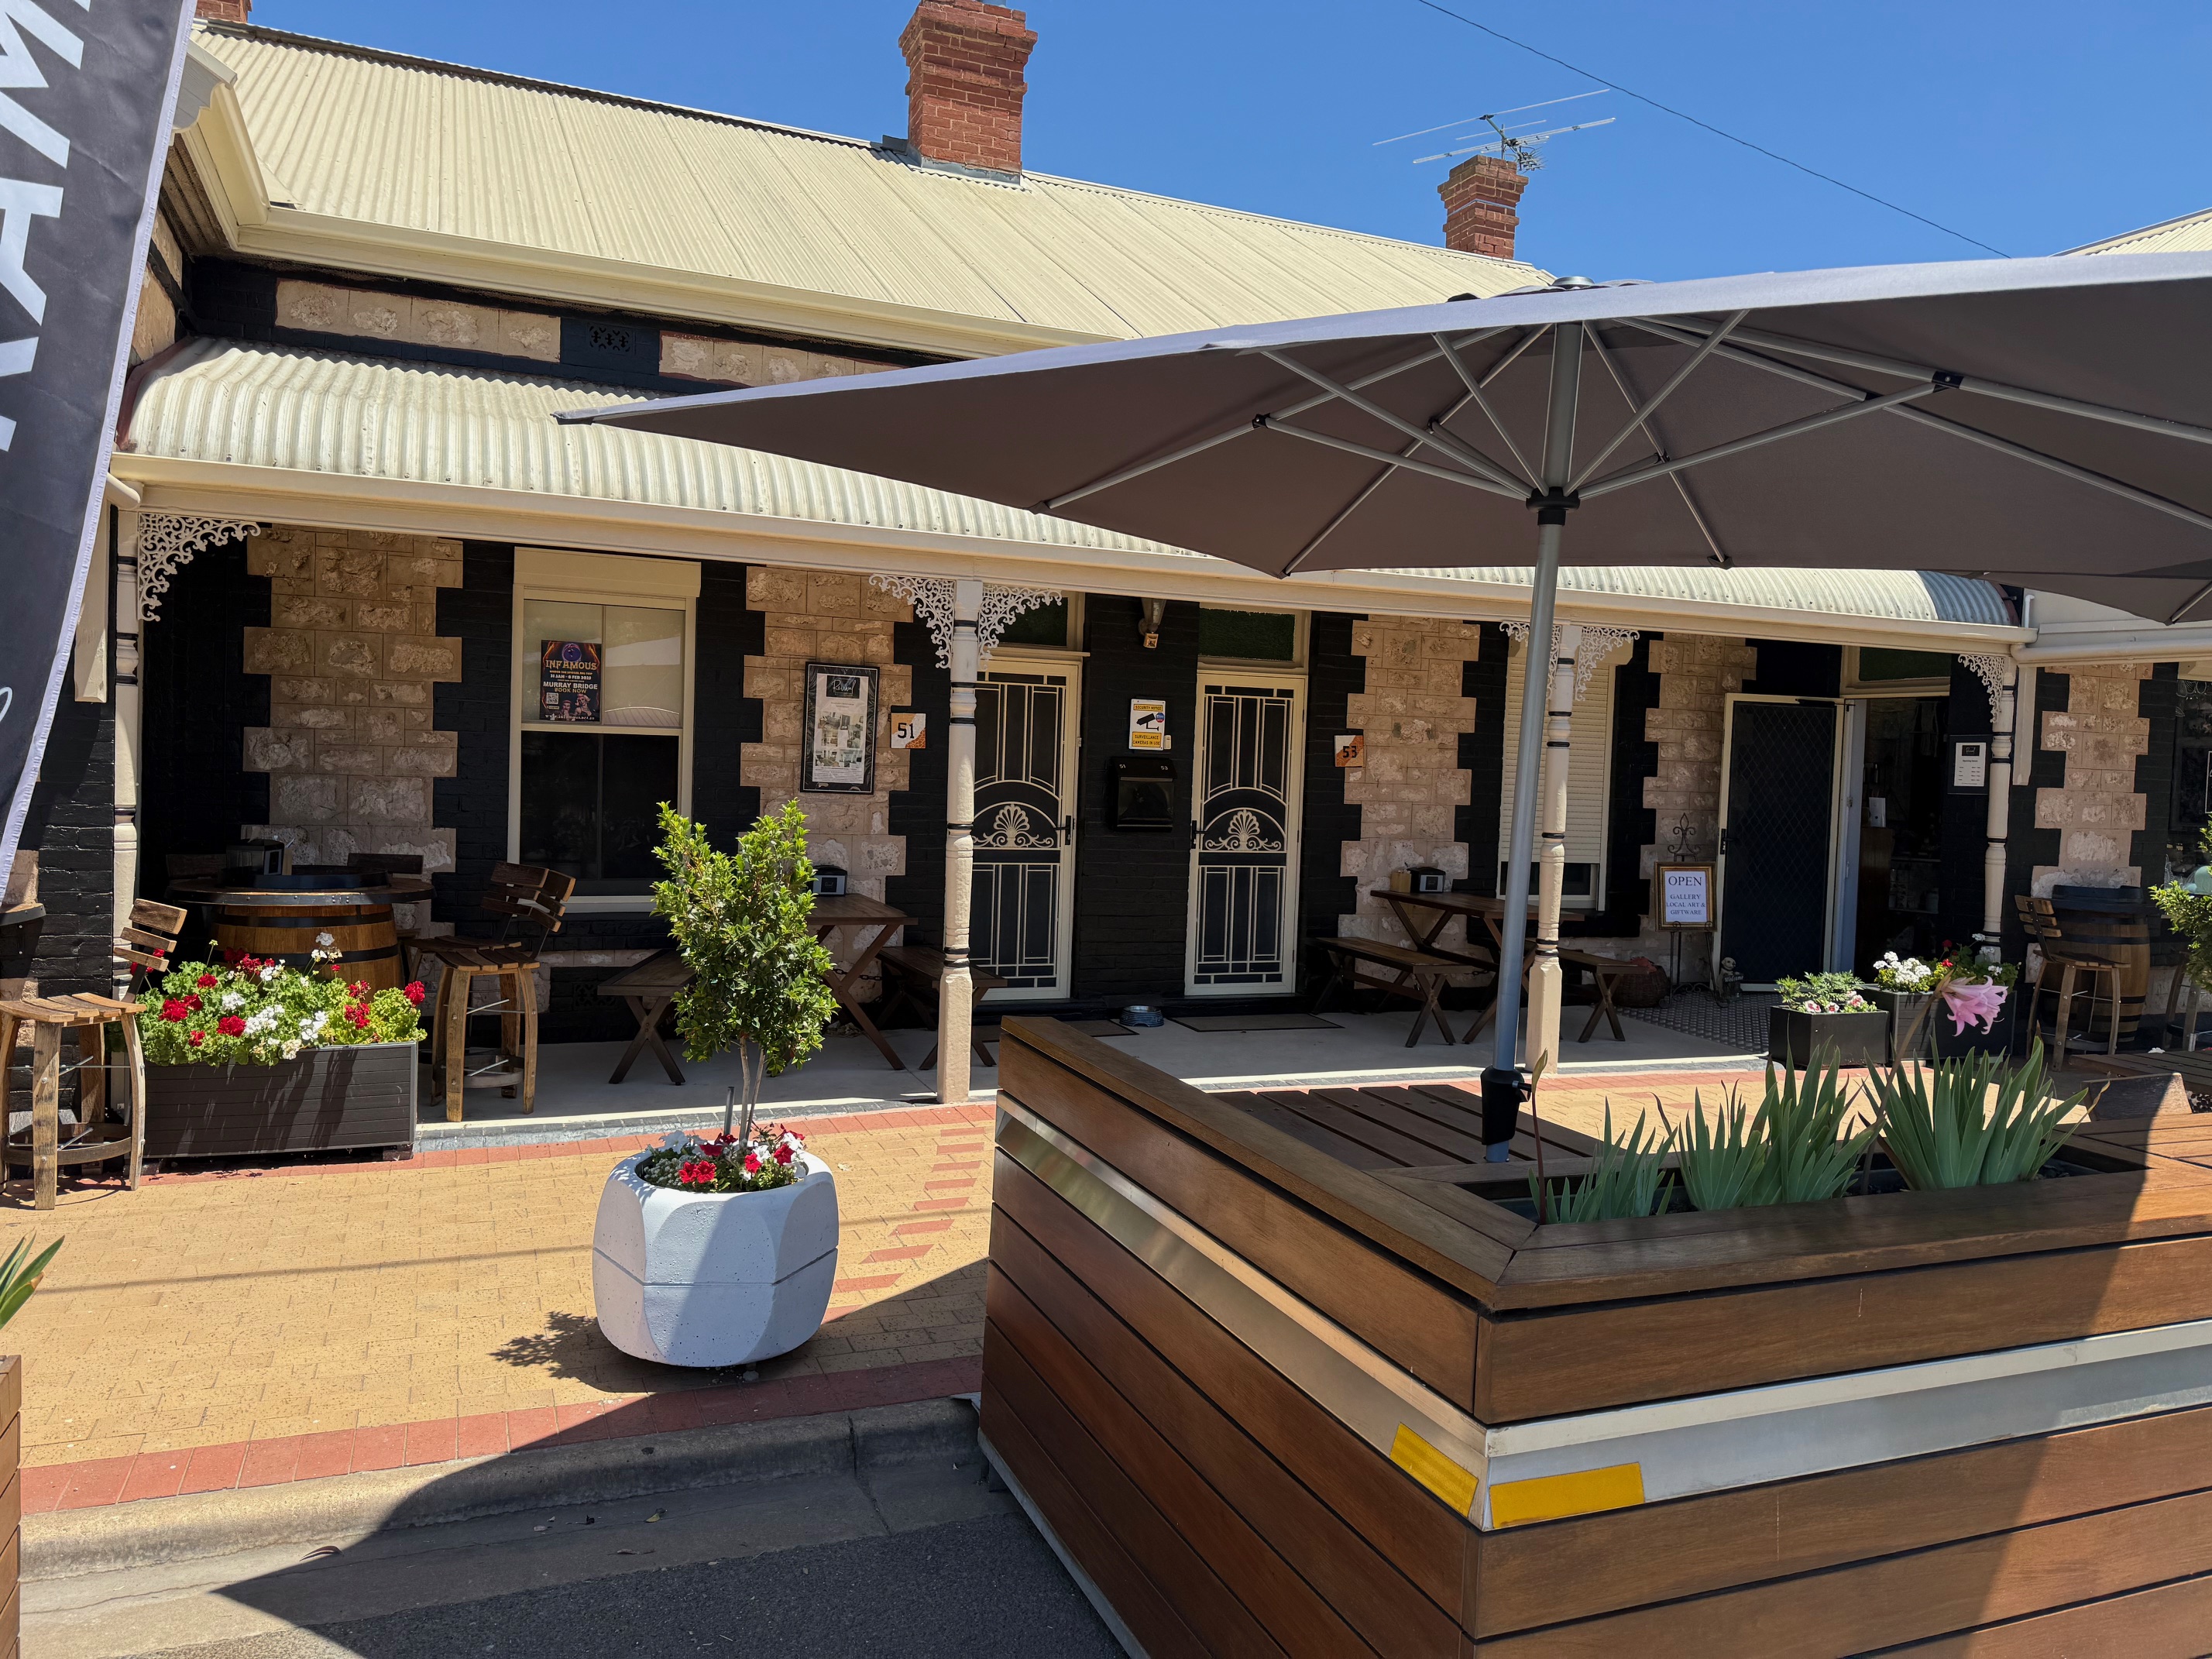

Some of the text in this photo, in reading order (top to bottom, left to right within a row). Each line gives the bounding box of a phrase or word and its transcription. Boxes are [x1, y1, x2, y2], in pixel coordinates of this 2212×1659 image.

[545, 660, 597, 671] INFAMOUS
[898, 723, 915, 739] 51
[1342, 745, 1358, 758] 53
[1668, 875, 1702, 886] OPEN
